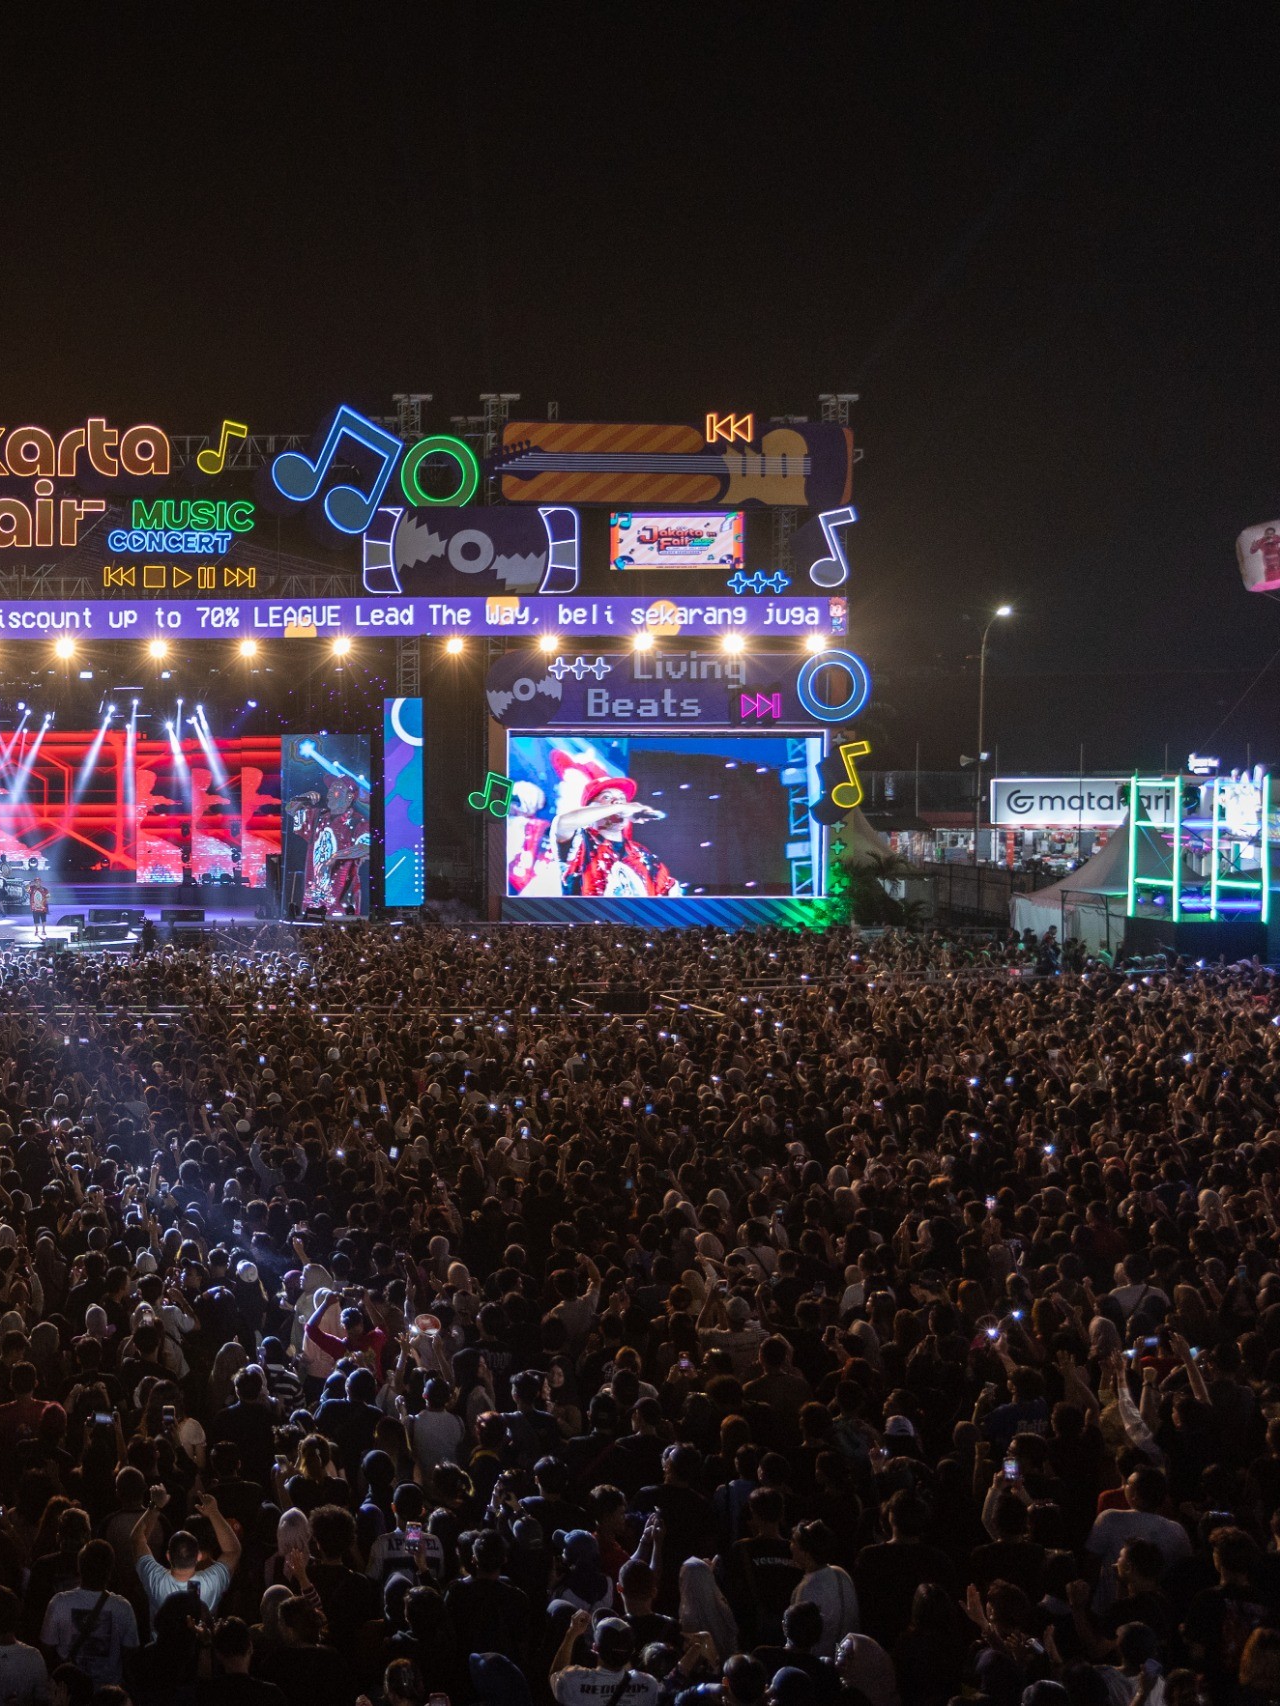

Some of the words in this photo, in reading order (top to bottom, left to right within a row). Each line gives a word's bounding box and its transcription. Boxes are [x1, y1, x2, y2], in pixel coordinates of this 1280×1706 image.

[132, 499, 256, 533] MUSIC
[108, 529, 233, 554] CONCERT
[108, 609, 138, 628] up
[155, 607, 182, 628] to
[196, 606, 240, 628] 70%
[254, 605, 342, 628] LEAGUE
[356, 604, 415, 627] Lead
[429, 603, 472, 625] The
[486, 603, 540, 626] Way,
[558, 603, 615, 626] beli
[631, 603, 748, 627] sekarang
[763, 602, 820, 627] juga
[634, 650, 747, 690] Living
[587, 688, 703, 718] Beats
[387, 1538, 440, 1551] APEL
